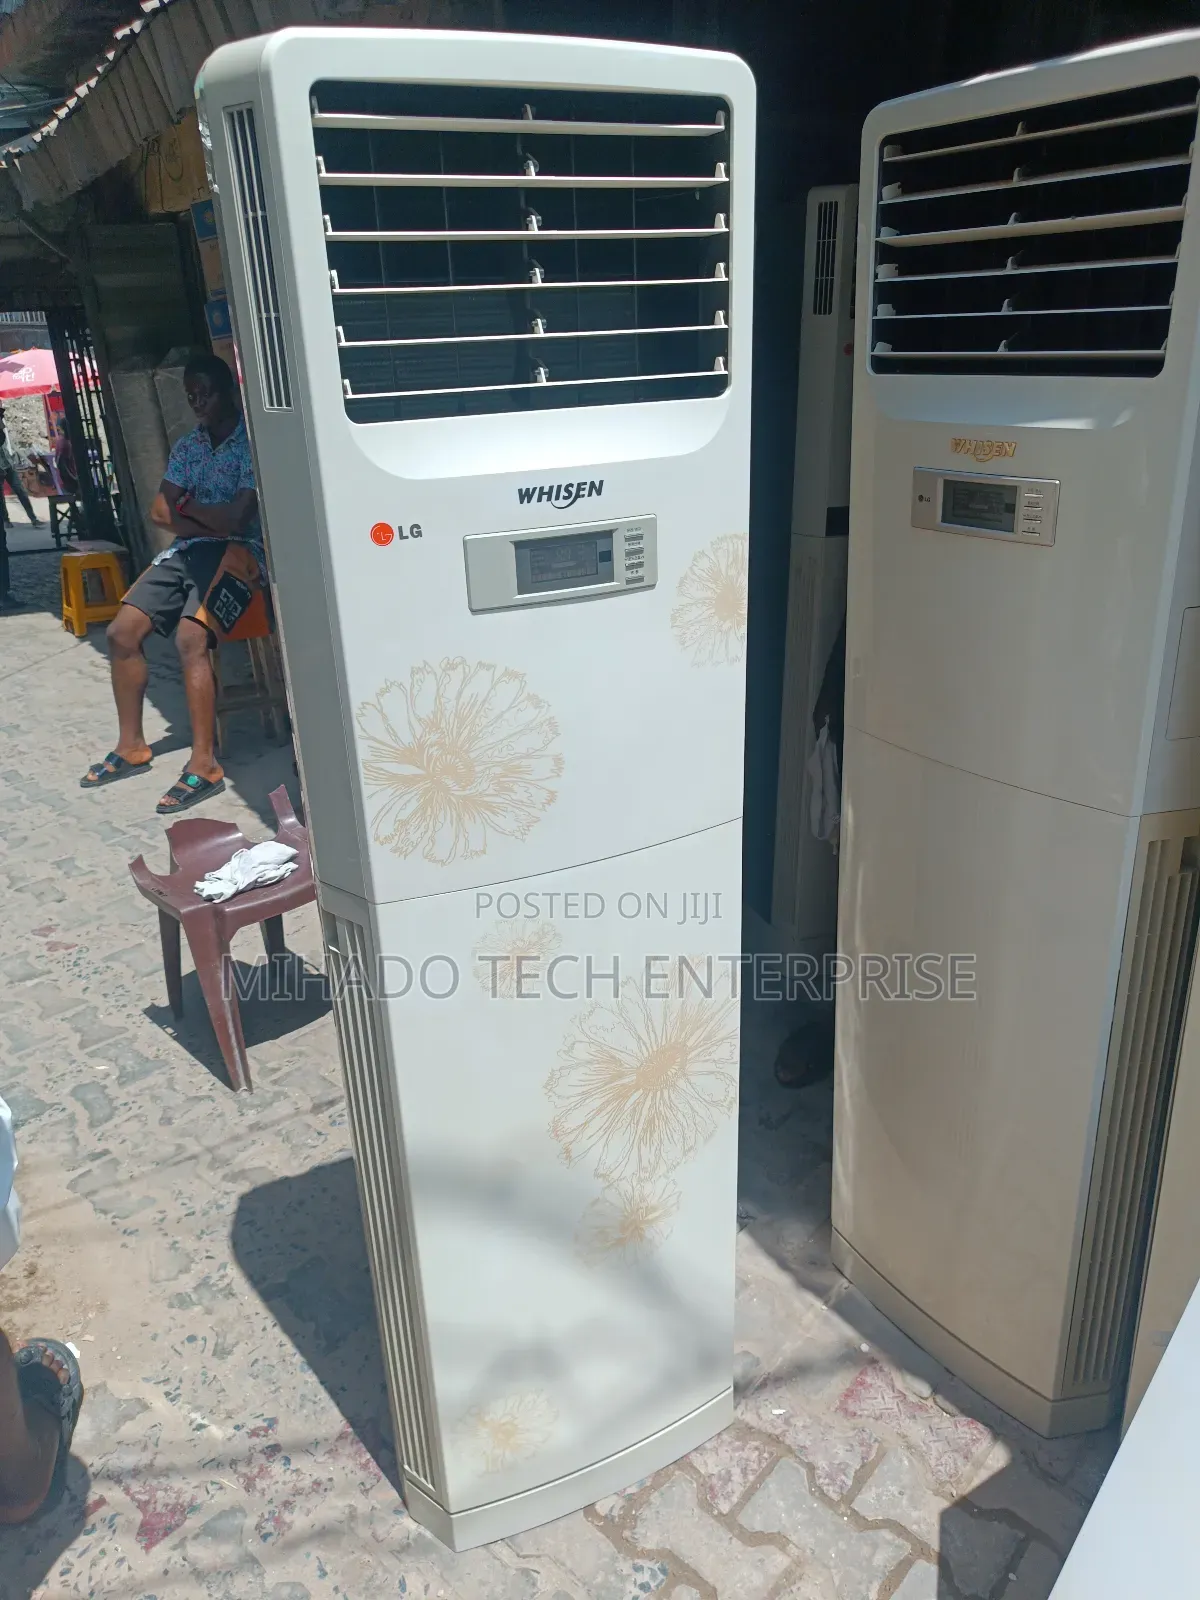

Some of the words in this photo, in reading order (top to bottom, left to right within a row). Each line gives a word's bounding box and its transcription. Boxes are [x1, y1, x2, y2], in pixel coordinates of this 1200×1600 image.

[951, 438, 1017, 462] WHISEN
[517, 479, 604, 509] WHISEN
[397, 523, 423, 540] LG
